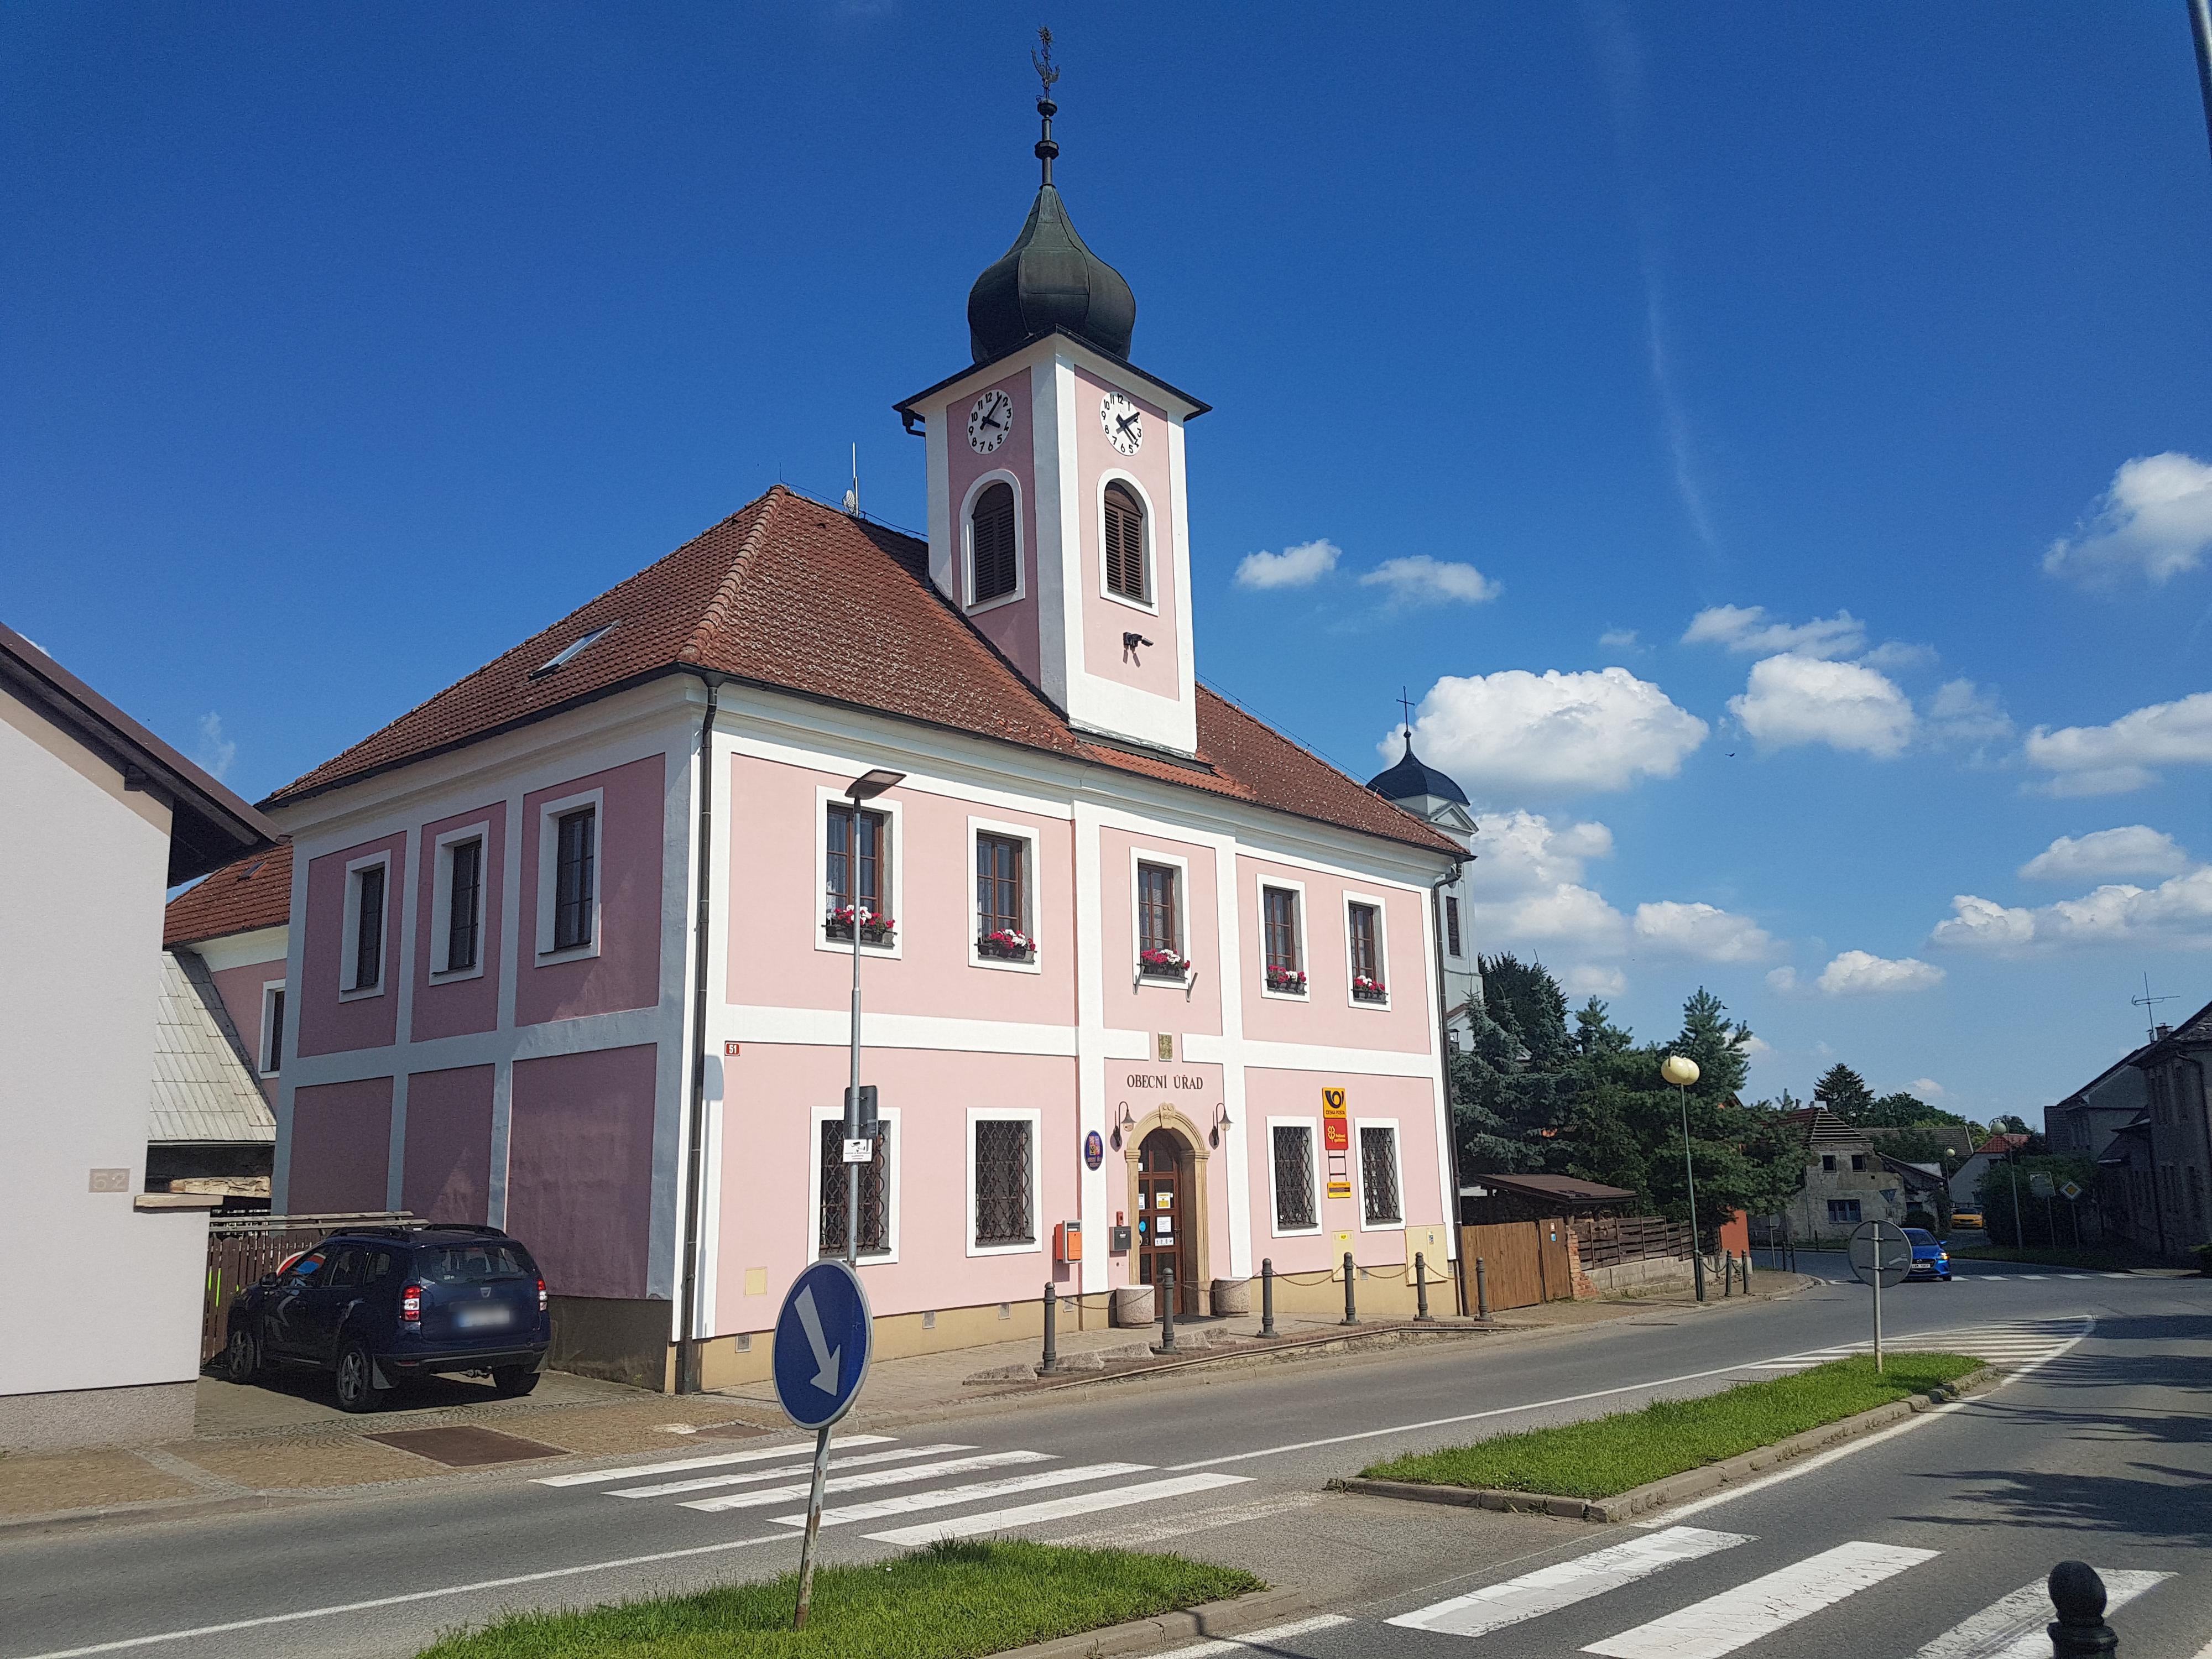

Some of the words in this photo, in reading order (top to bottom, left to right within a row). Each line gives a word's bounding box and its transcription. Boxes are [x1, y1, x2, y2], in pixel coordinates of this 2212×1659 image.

[985, 392, 992, 403] 12
[1003, 397, 1009, 408] 2
[1110, 393, 1114, 405] 11
[1118, 393, 1124, 405] 12
[978, 400, 983, 411] 11
[1104, 399, 1110, 410] 10
[1128, 401, 1130, 411] 1
[971, 411, 978, 422] 10
[1006, 408, 1011, 419] 3
[1101, 410, 1106, 420] 9
[968, 426, 974, 436] 9
[1004, 421, 1009, 431] 4
[1105, 425, 1109, 434] 8
[1137, 427, 1142, 437] 3
[972, 437, 977, 447] 8
[997, 434, 1003, 444] 5
[1112, 435, 1117, 445] 7
[980, 441, 985, 452] 7
[988, 441, 993, 452] 6
[1120, 443, 1125, 453] 6
[1129, 444, 1134, 453] 5
[729, 1044, 737, 1054] 51
[1127, 1074, 1167, 1088] OBECNÍ
[1173, 1074, 1203, 1089] ÚŘAD
